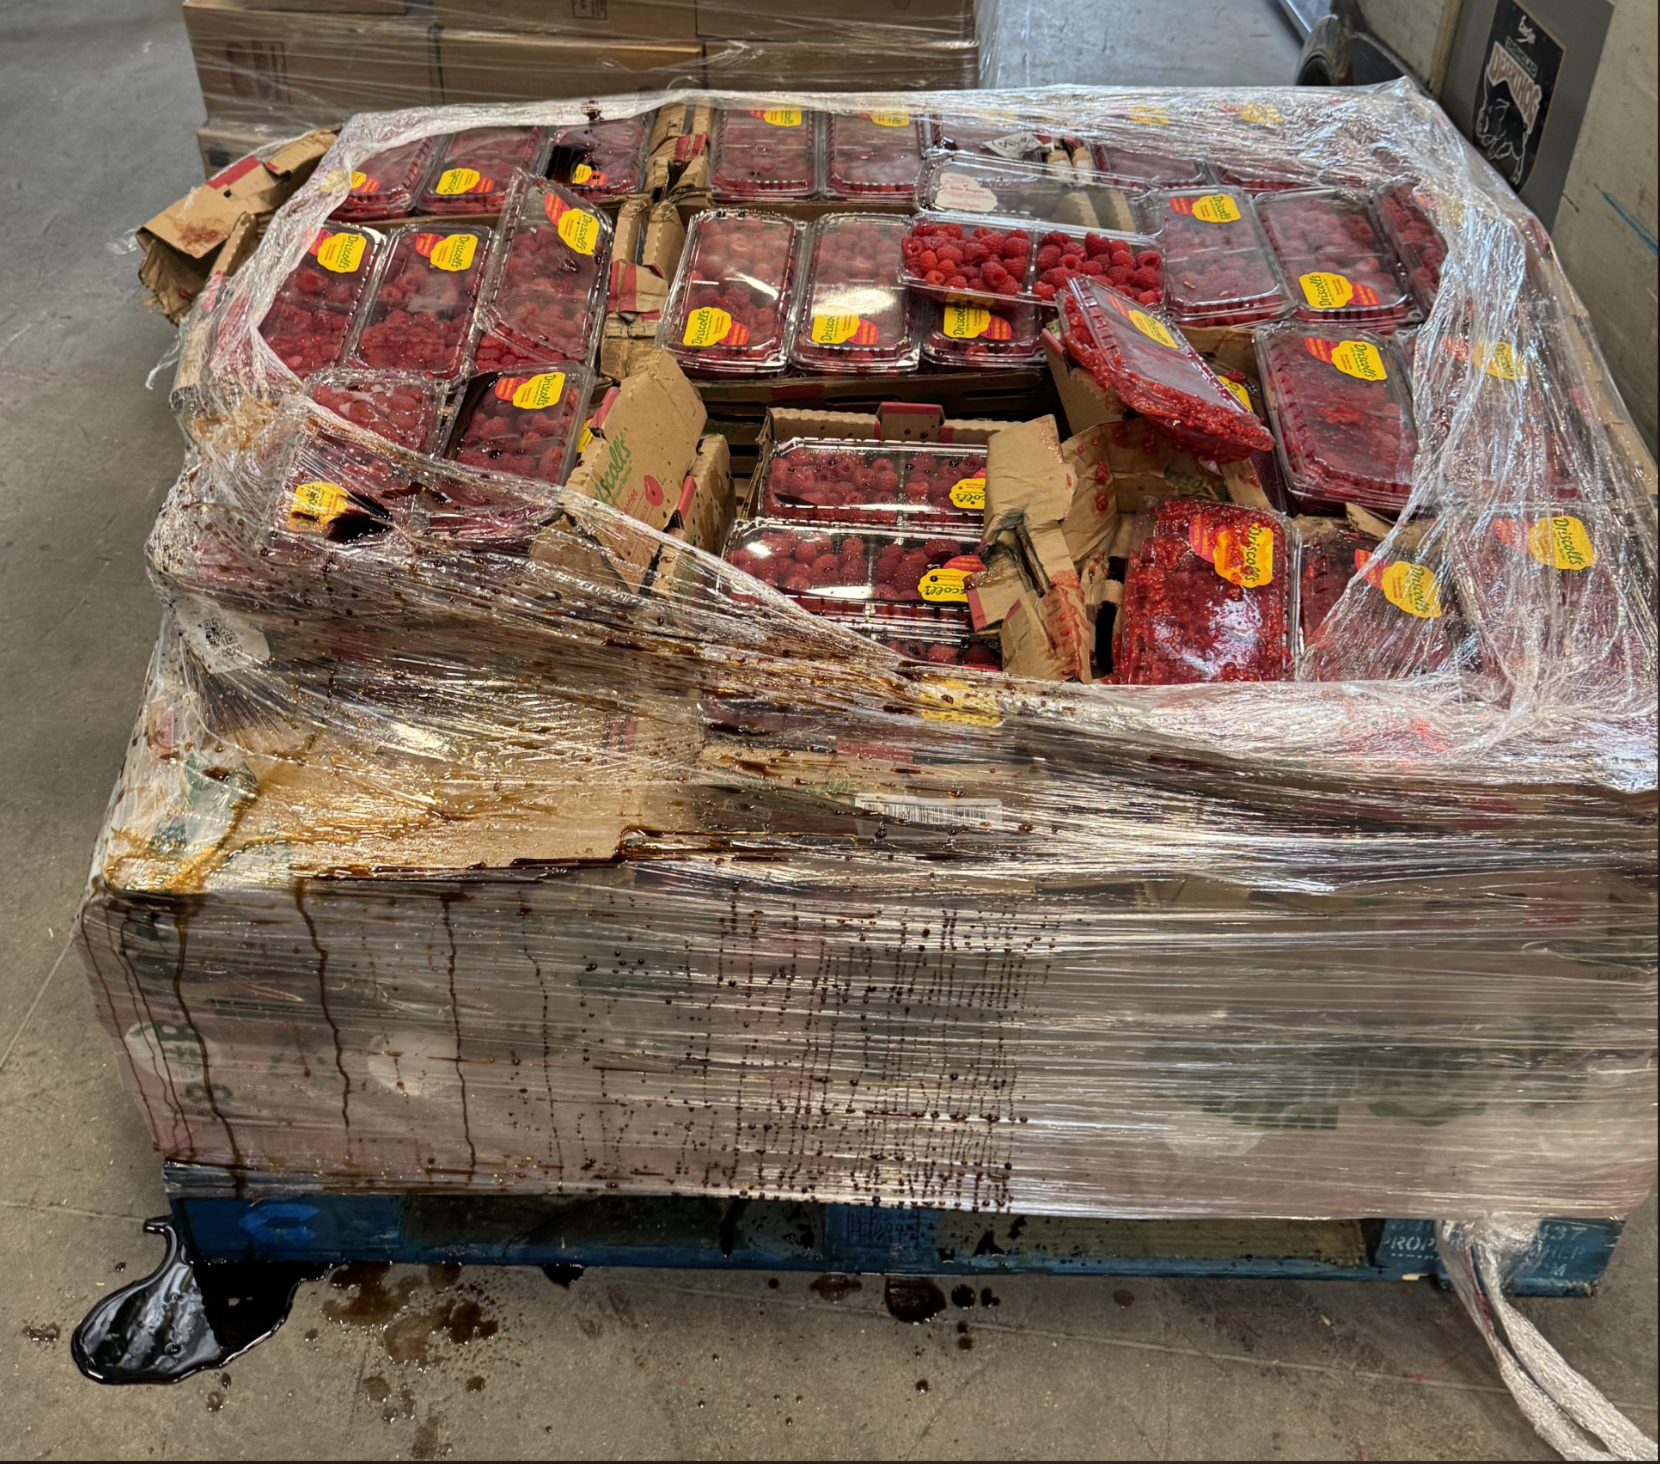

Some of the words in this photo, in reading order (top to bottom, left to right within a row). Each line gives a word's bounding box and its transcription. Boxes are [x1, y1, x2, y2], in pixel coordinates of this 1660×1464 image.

[337, 233, 361, 271] Driscoll's
[450, 233, 471, 271] Driscoll's
[1311, 273, 1332, 308] Driscoll's
[691, 307, 711, 345] Driscoll's
[1353, 343, 1377, 379] Driscoll's
[535, 373, 558, 407] Driscoll's
[1552, 516, 1583, 566] Driscoll's
